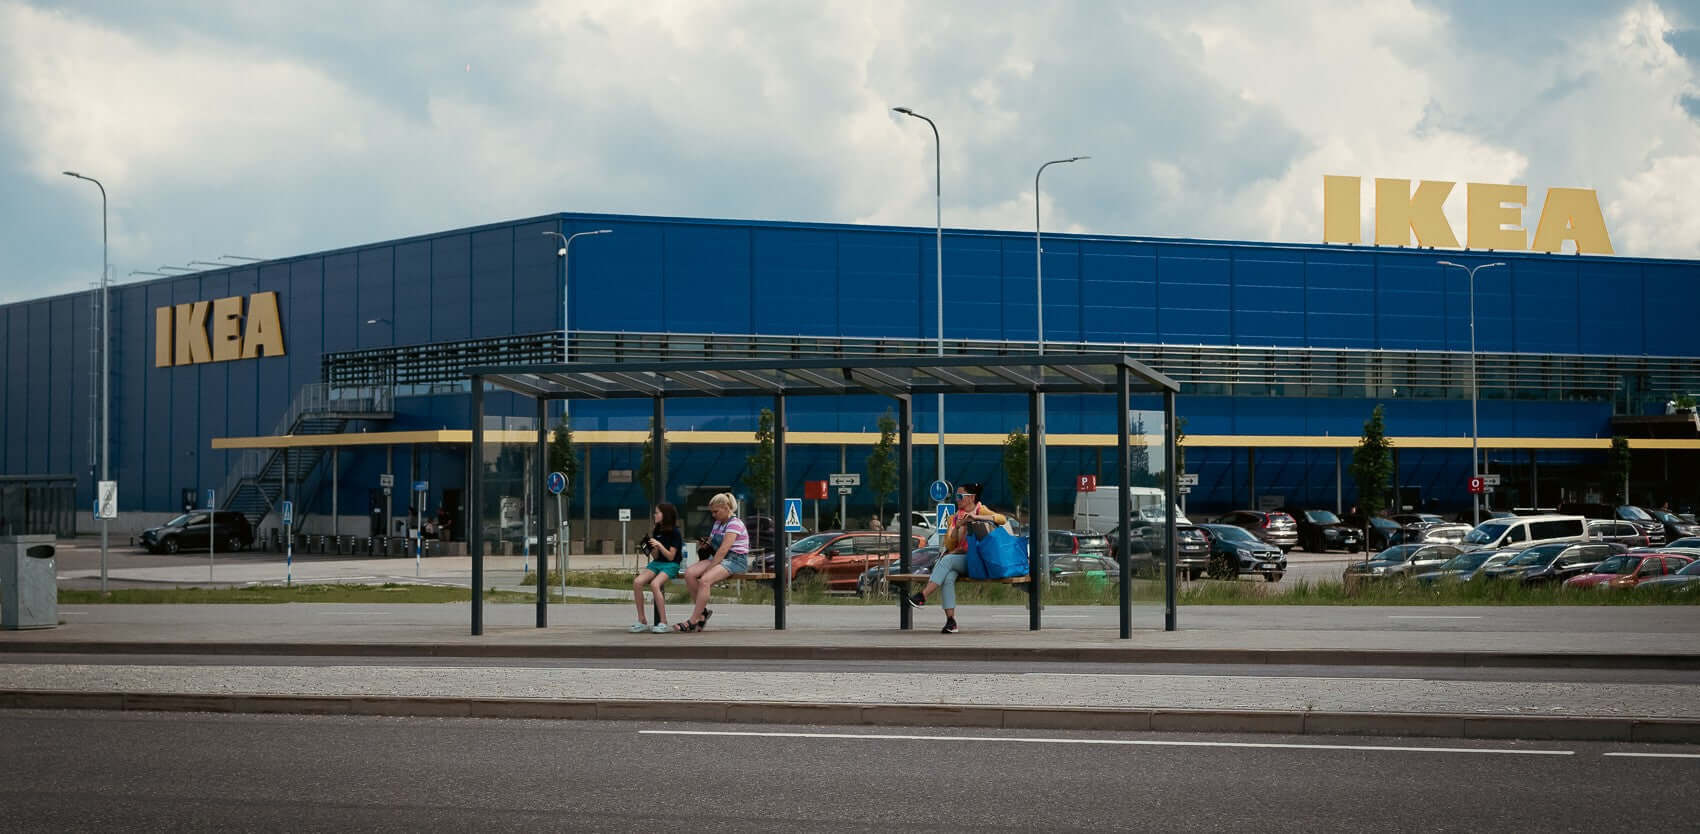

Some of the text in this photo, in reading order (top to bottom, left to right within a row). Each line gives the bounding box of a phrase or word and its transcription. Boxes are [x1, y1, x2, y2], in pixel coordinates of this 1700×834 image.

[1323, 175, 1615, 255] IKEA
[155, 291, 286, 368] IKEA
[1081, 477, 1088, 486] P
